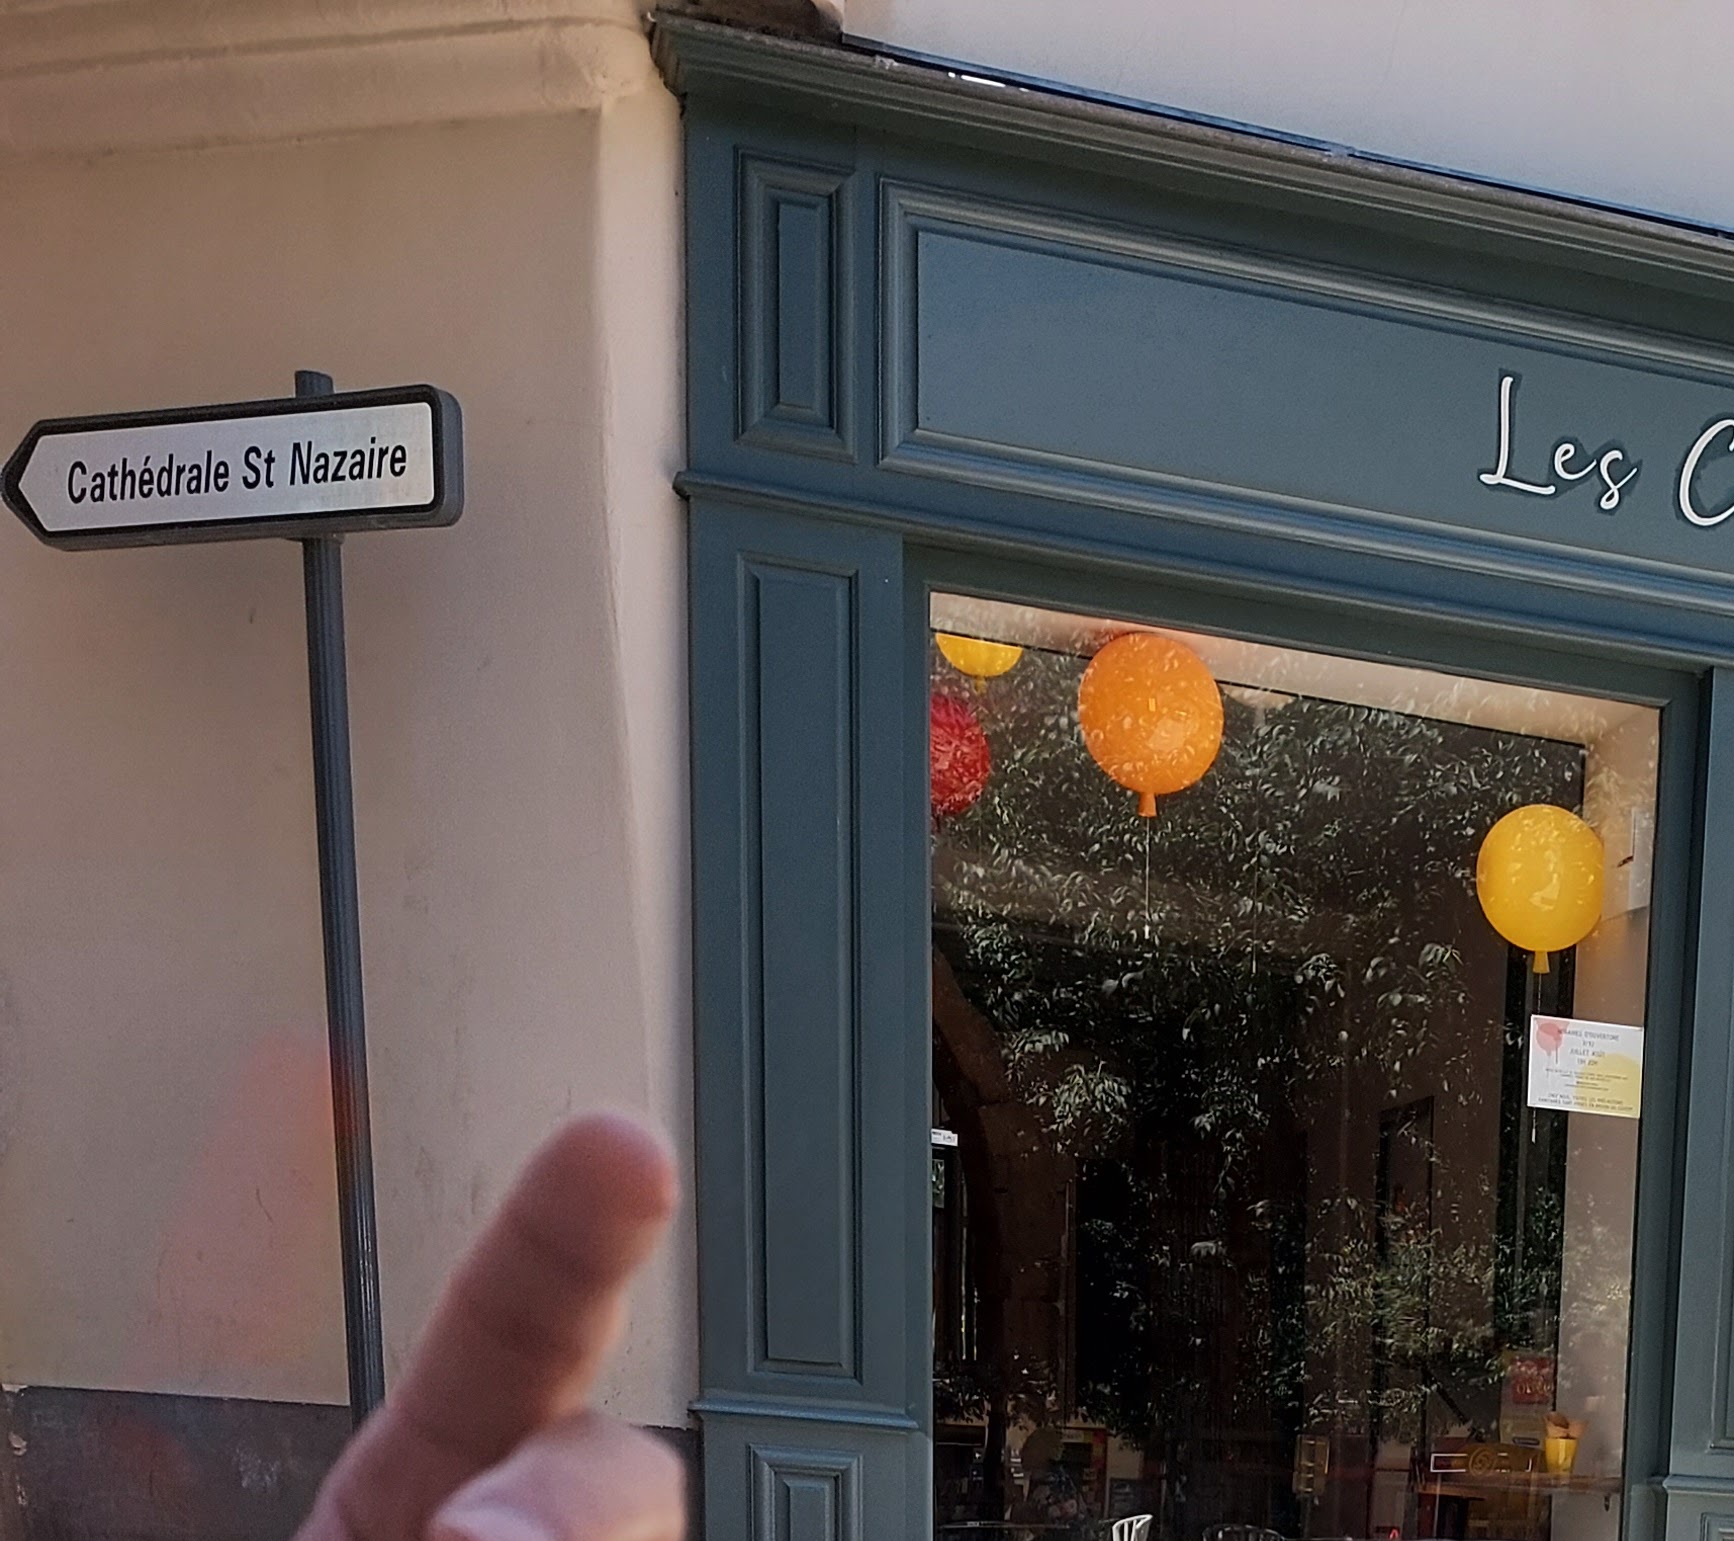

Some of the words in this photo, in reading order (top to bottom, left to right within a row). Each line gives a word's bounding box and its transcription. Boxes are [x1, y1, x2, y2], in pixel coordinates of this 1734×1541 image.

[67, 450, 230, 504] Cathédrale
[241, 445, 276, 490] St
[289, 437, 408, 486] Nazaire
[1479, 375, 1640, 512] Les
